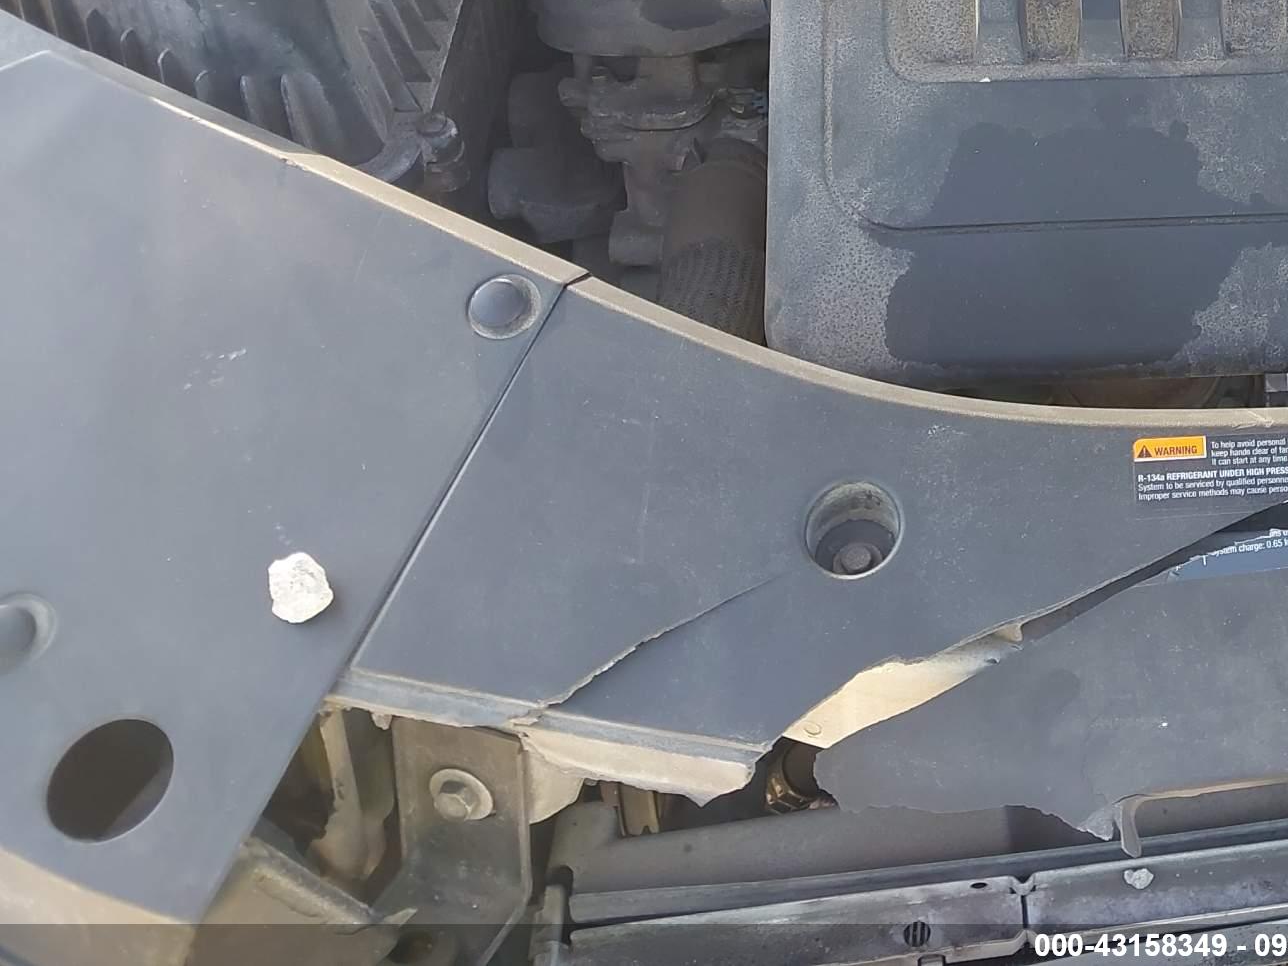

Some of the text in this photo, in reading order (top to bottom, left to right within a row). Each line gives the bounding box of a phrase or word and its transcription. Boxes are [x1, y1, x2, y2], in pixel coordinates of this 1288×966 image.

[1221, 441, 1235, 449] help
[1237, 439, 1255, 448] avoid
[1257, 438, 1286, 447] personal
[1154, 446, 1197, 455] WARNING
[1211, 449, 1228, 457] keep
[1230, 448, 1250, 456] hands
[1259, 456, 1271, 464] any
[1138, 474, 1165, 482] R-134a
[1167, 470, 1217, 480] REFRIGERANT
[1220, 468, 1244, 477] UNDER
[1247, 467, 1264, 476] HIGH
[1138, 483, 1164, 492] System
[1185, 480, 1214, 488] serviced
[1216, 480, 1224, 488] by
[1226, 477, 1255, 487] qualified
[1139, 493, 1170, 501] Improper
[1199, 488, 1228, 497] methods
[1230, 488, 1245, 496] may
[1239, 542, 1265, 552] charge:
[1266, 540, 1282, 549] 0.65
